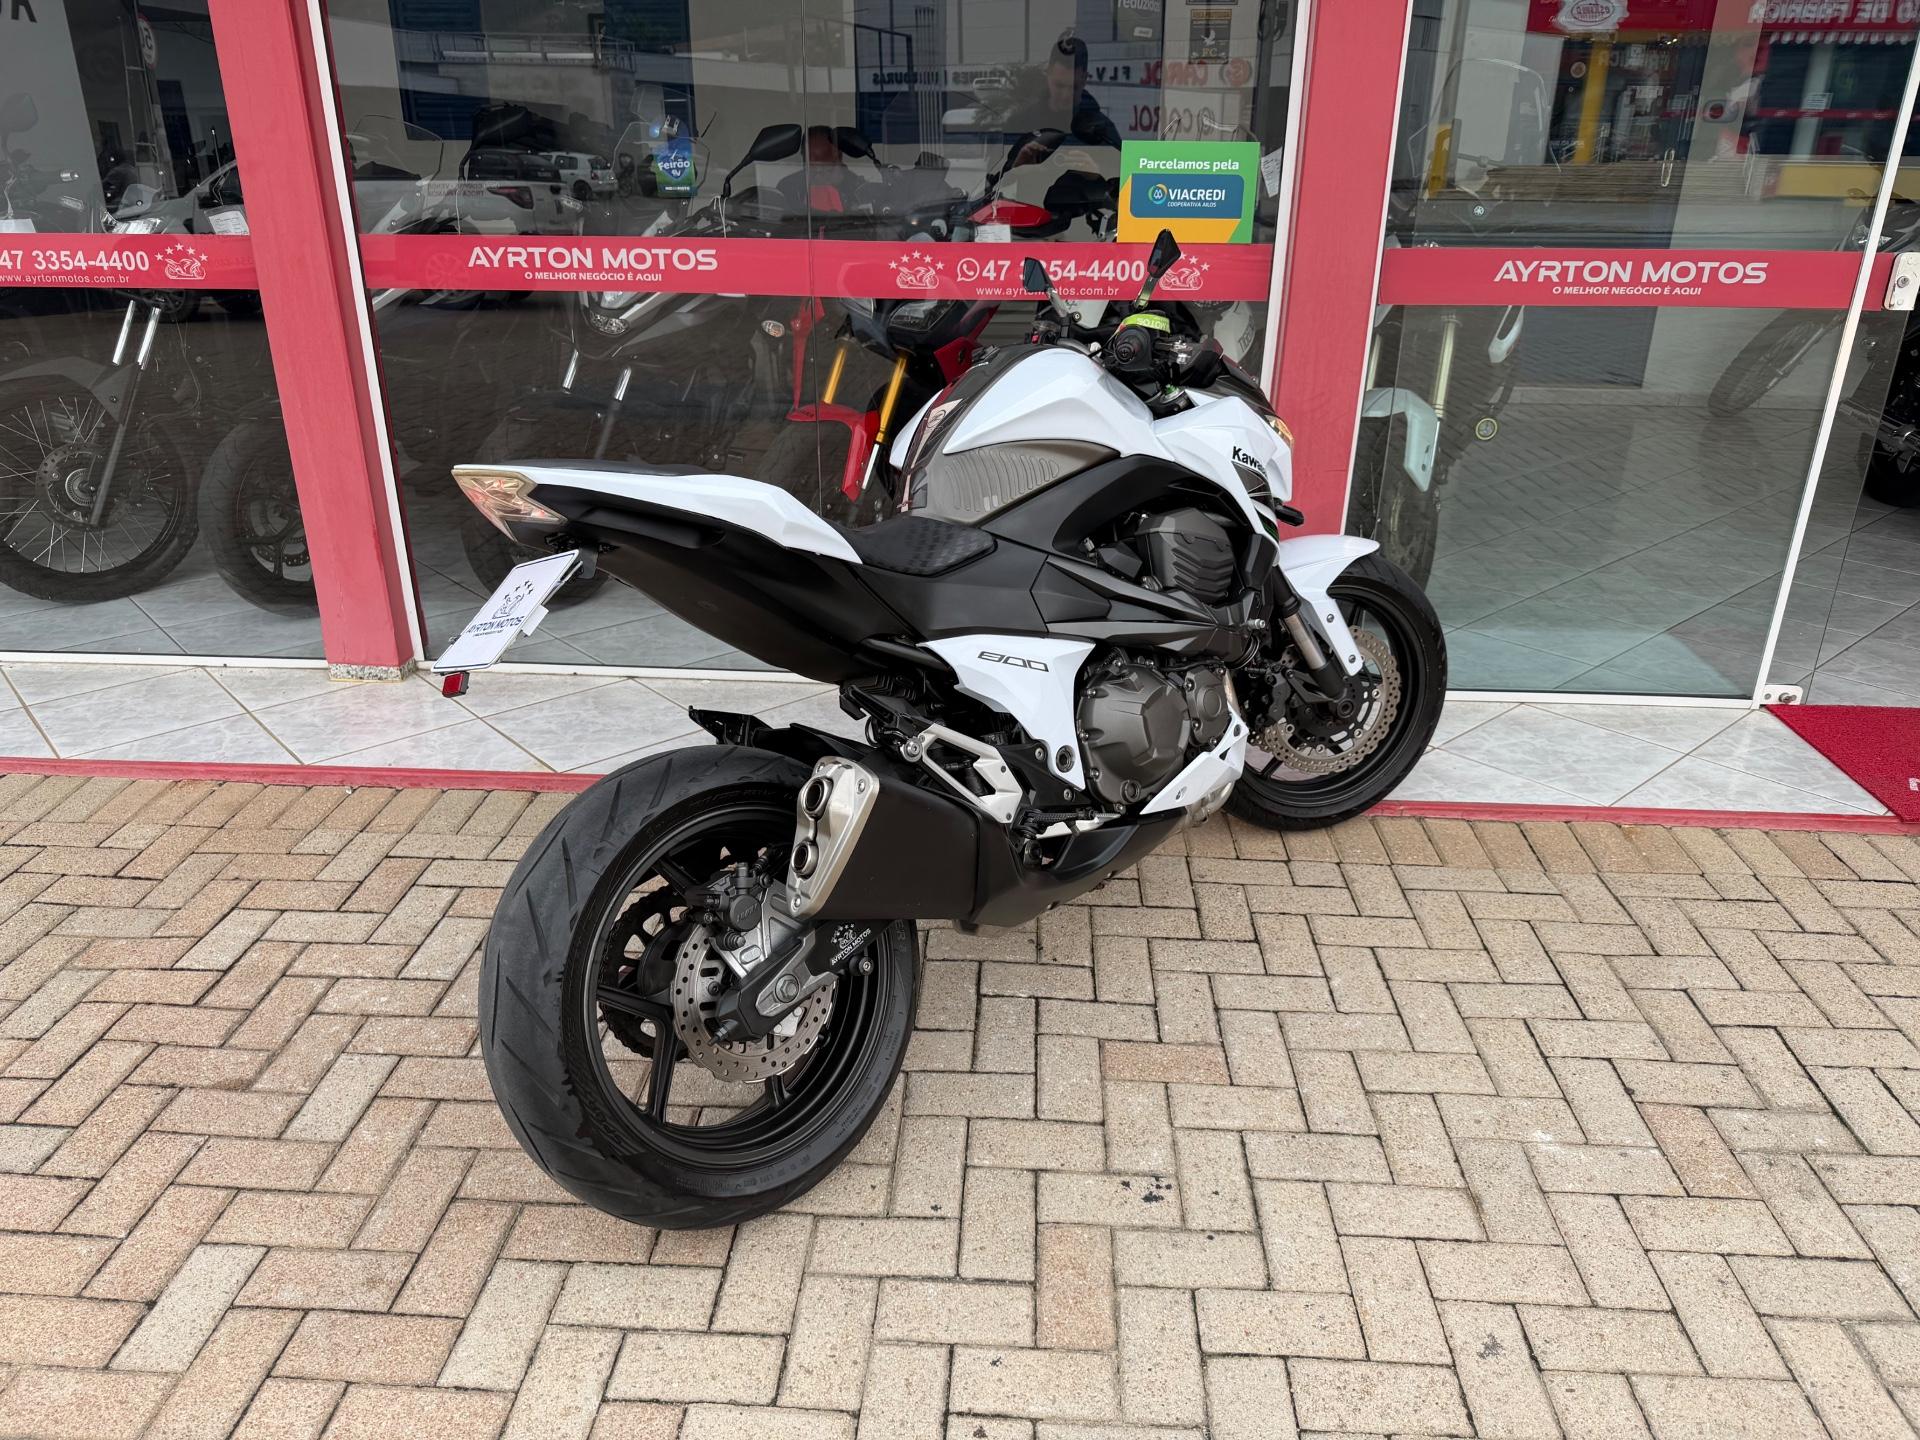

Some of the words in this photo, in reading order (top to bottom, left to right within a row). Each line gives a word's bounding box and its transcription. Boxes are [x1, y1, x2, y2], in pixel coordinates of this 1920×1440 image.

[658, 158, 690, 171] Feirão
[1139, 158, 1210, 170] Parcelamos
[1213, 160, 1239, 171] pela
[1168, 189, 1225, 201] VIACREDI
[0, 250, 23, 270] 47
[32, 250, 149, 271] 3354-4400
[468, 246, 593, 269] AYRTON
[603, 247, 718, 271] MOTOS
[524, 271, 533, 280] O
[535, 272, 577, 280] MELHOR
[579, 271, 625, 281] NEGÓCIO
[627, 271, 634, 281] É
[635, 273, 662, 282] AQUI
[982, 259, 1010, 281] 47
[1019, 259, 1145, 282] 54-4400
[1493, 260, 1634, 283] AYRTON
[1641, 261, 1769, 284] MOTOS
[1552, 285, 1561, 295] O
[1563, 285, 1609, 296] MELHOR
[1611, 285, 1662, 296] NEGÓCIO
[1664, 285, 1671, 297] É
[1673, 286, 1702, 297] AQUI
[977, 651, 1049, 672] 800
[852, 928, 871, 946] MOTOS
